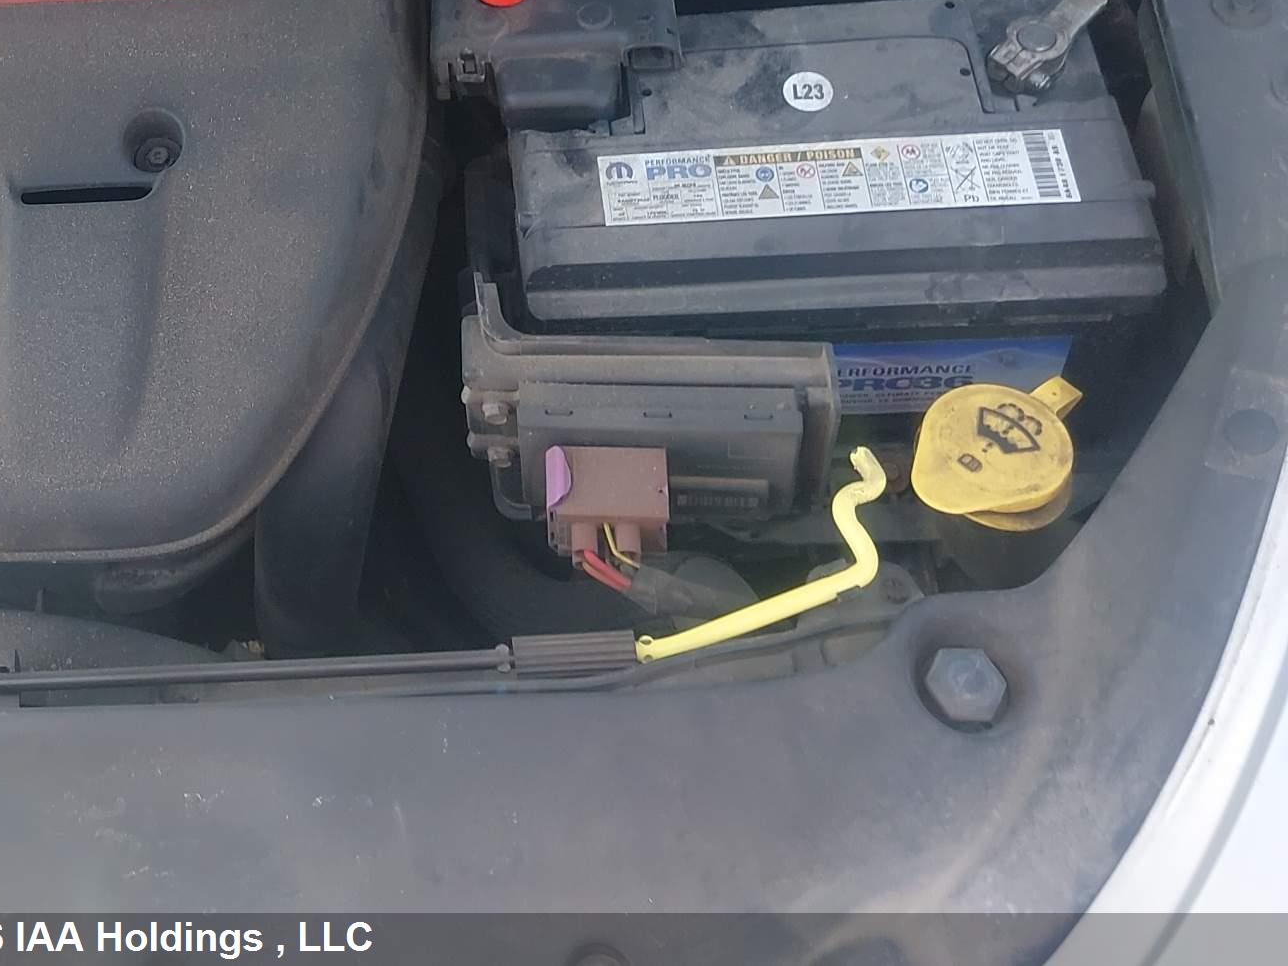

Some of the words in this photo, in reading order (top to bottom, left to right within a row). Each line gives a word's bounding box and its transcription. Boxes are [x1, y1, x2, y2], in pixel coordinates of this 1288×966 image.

[792, 83, 825, 100] L23
[644, 154, 711, 166] PERFORMANCE
[739, 153, 791, 165] DANGER
[806, 149, 855, 161] POISON
[645, 164, 712, 181] PRO
[837, 364, 975, 377] ERFORMANCE
